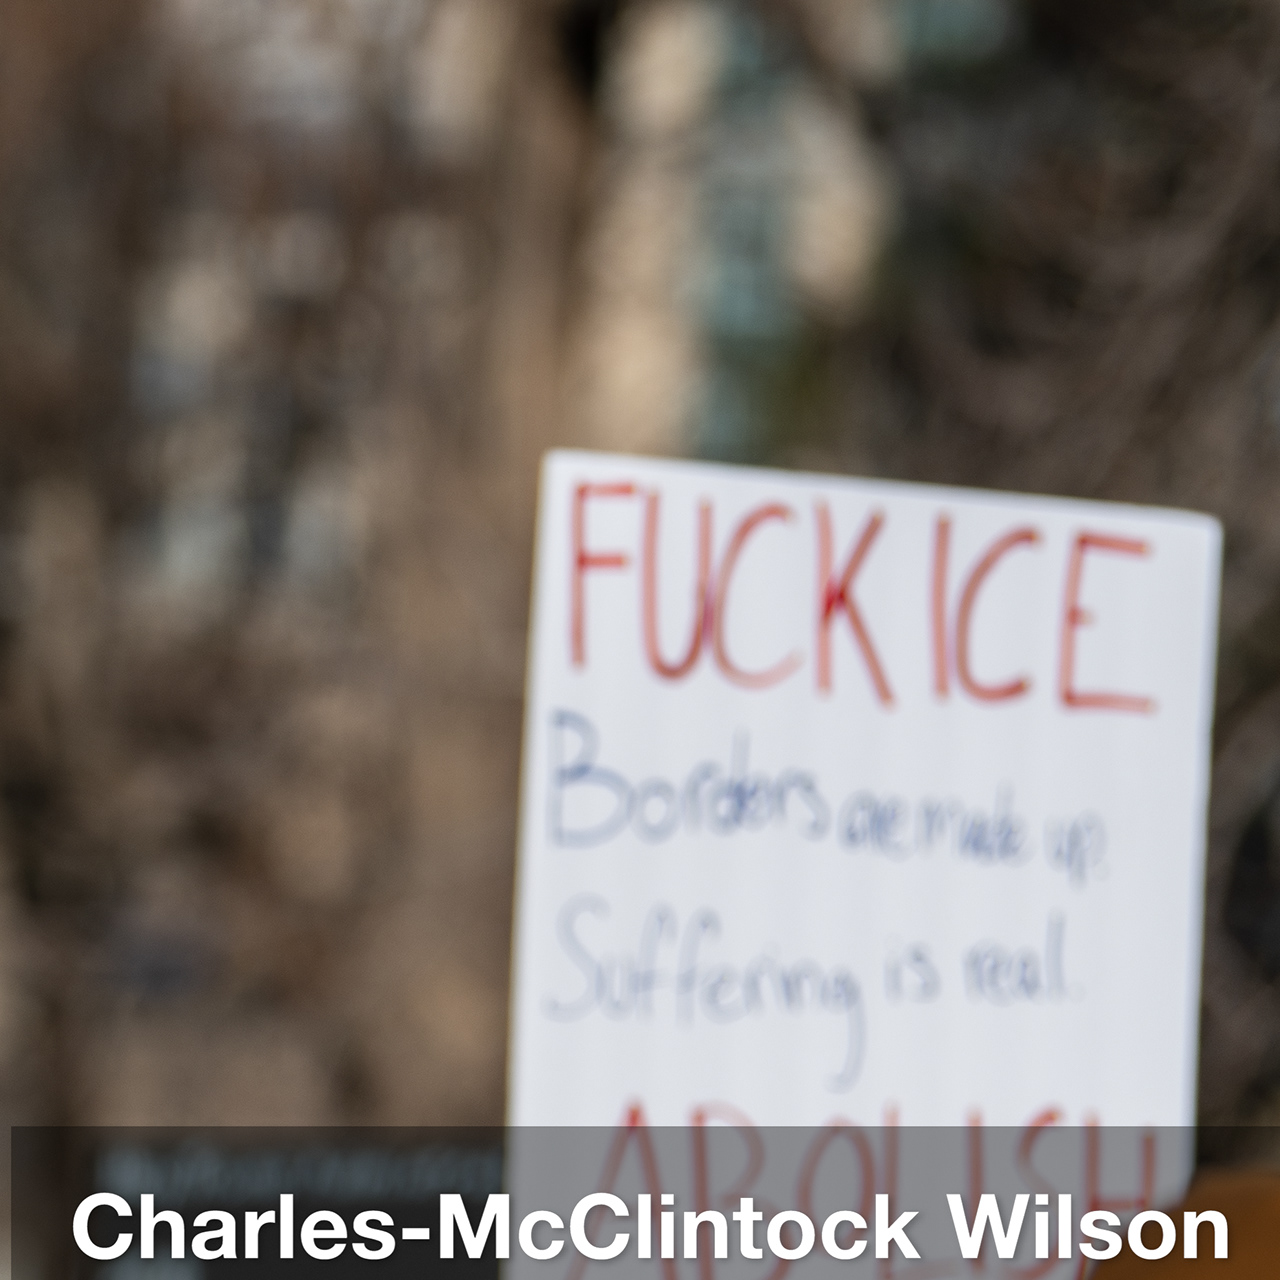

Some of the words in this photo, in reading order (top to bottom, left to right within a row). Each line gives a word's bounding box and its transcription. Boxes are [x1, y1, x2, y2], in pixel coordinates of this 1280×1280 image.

[568, 477, 896, 712] FUCK
[930, 511, 1162, 717] ICE
[543, 707, 831, 850] Borders
[540, 891, 869, 1094] Suffering
[884, 938, 943, 1004] is
